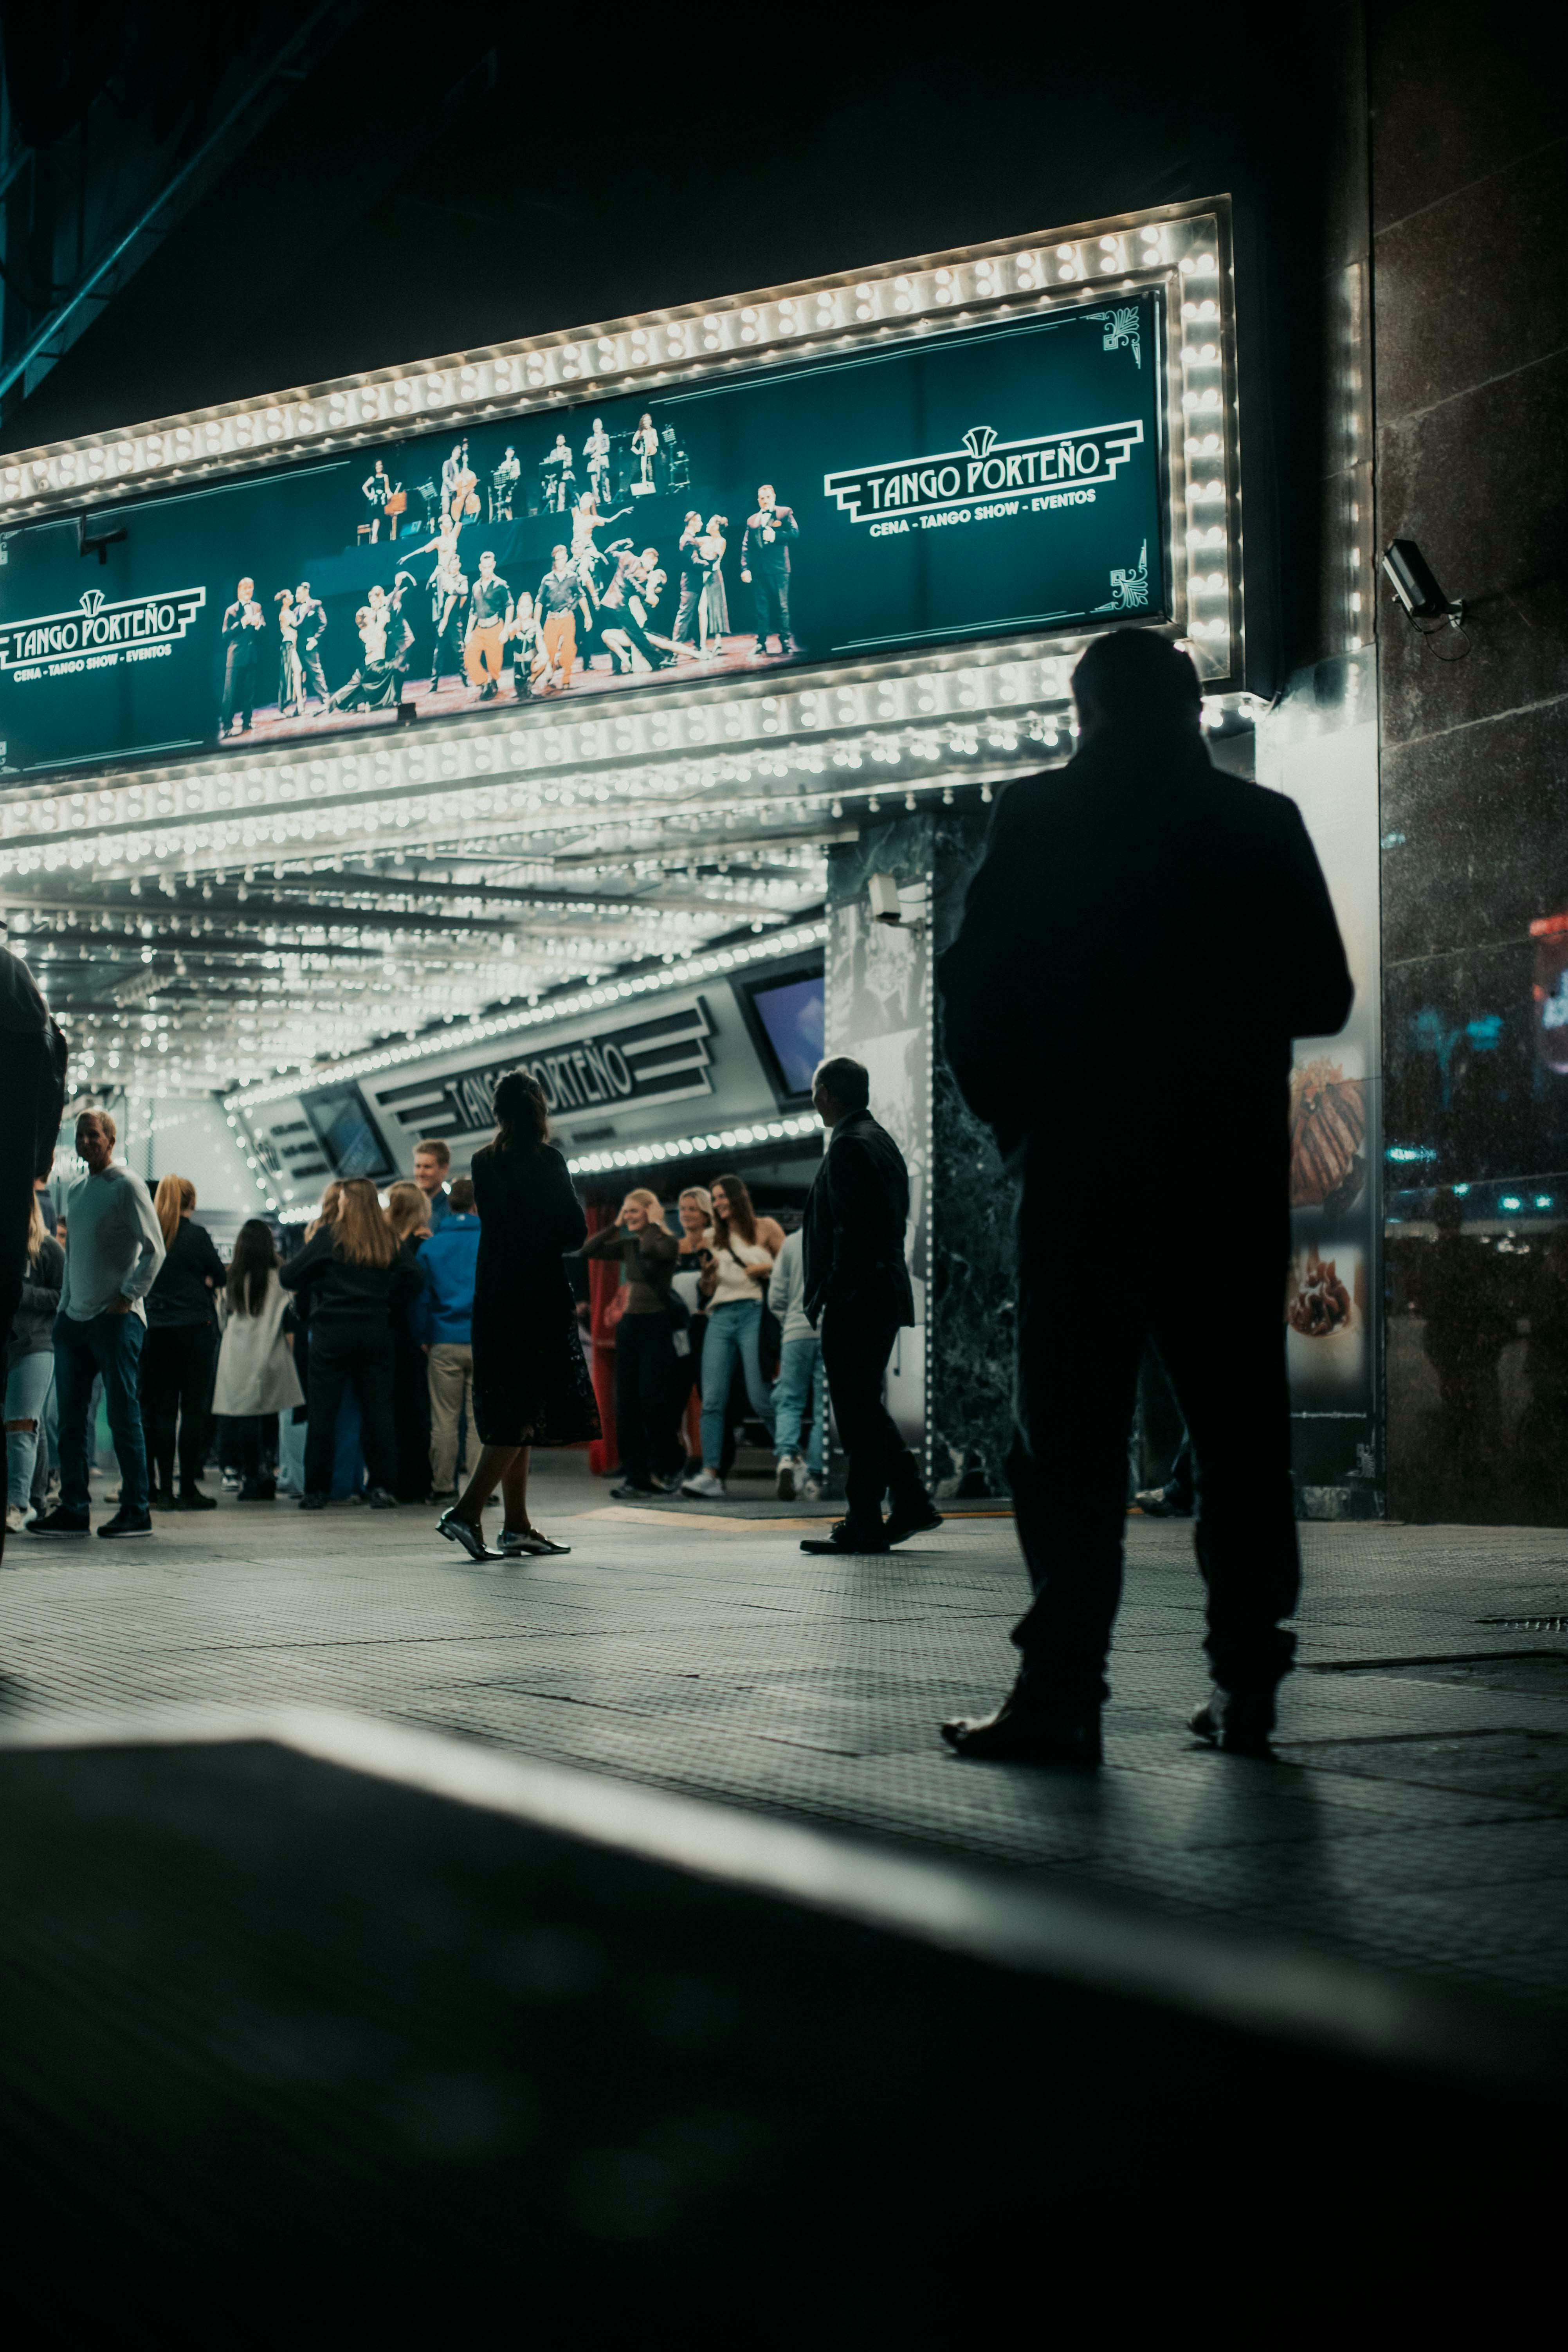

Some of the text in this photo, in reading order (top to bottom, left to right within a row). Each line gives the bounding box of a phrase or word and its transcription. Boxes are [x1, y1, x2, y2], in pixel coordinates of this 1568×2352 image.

[867, 440, 1099, 509] TANGO PORTEÑO
[869, 519, 910, 537] CENA
[919, 509, 971, 529] TANGO
[974, 501, 1019, 520] SHOW
[1031, 488, 1096, 512] EVENTOS
[13, 603, 175, 658] TANGO PORTEÑO
[13, 667, 42, 682] CENA
[48, 659, 85, 676] TANGO
[86, 653, 118, 670] SHOW
[126, 643, 172, 662] EVENTOS
